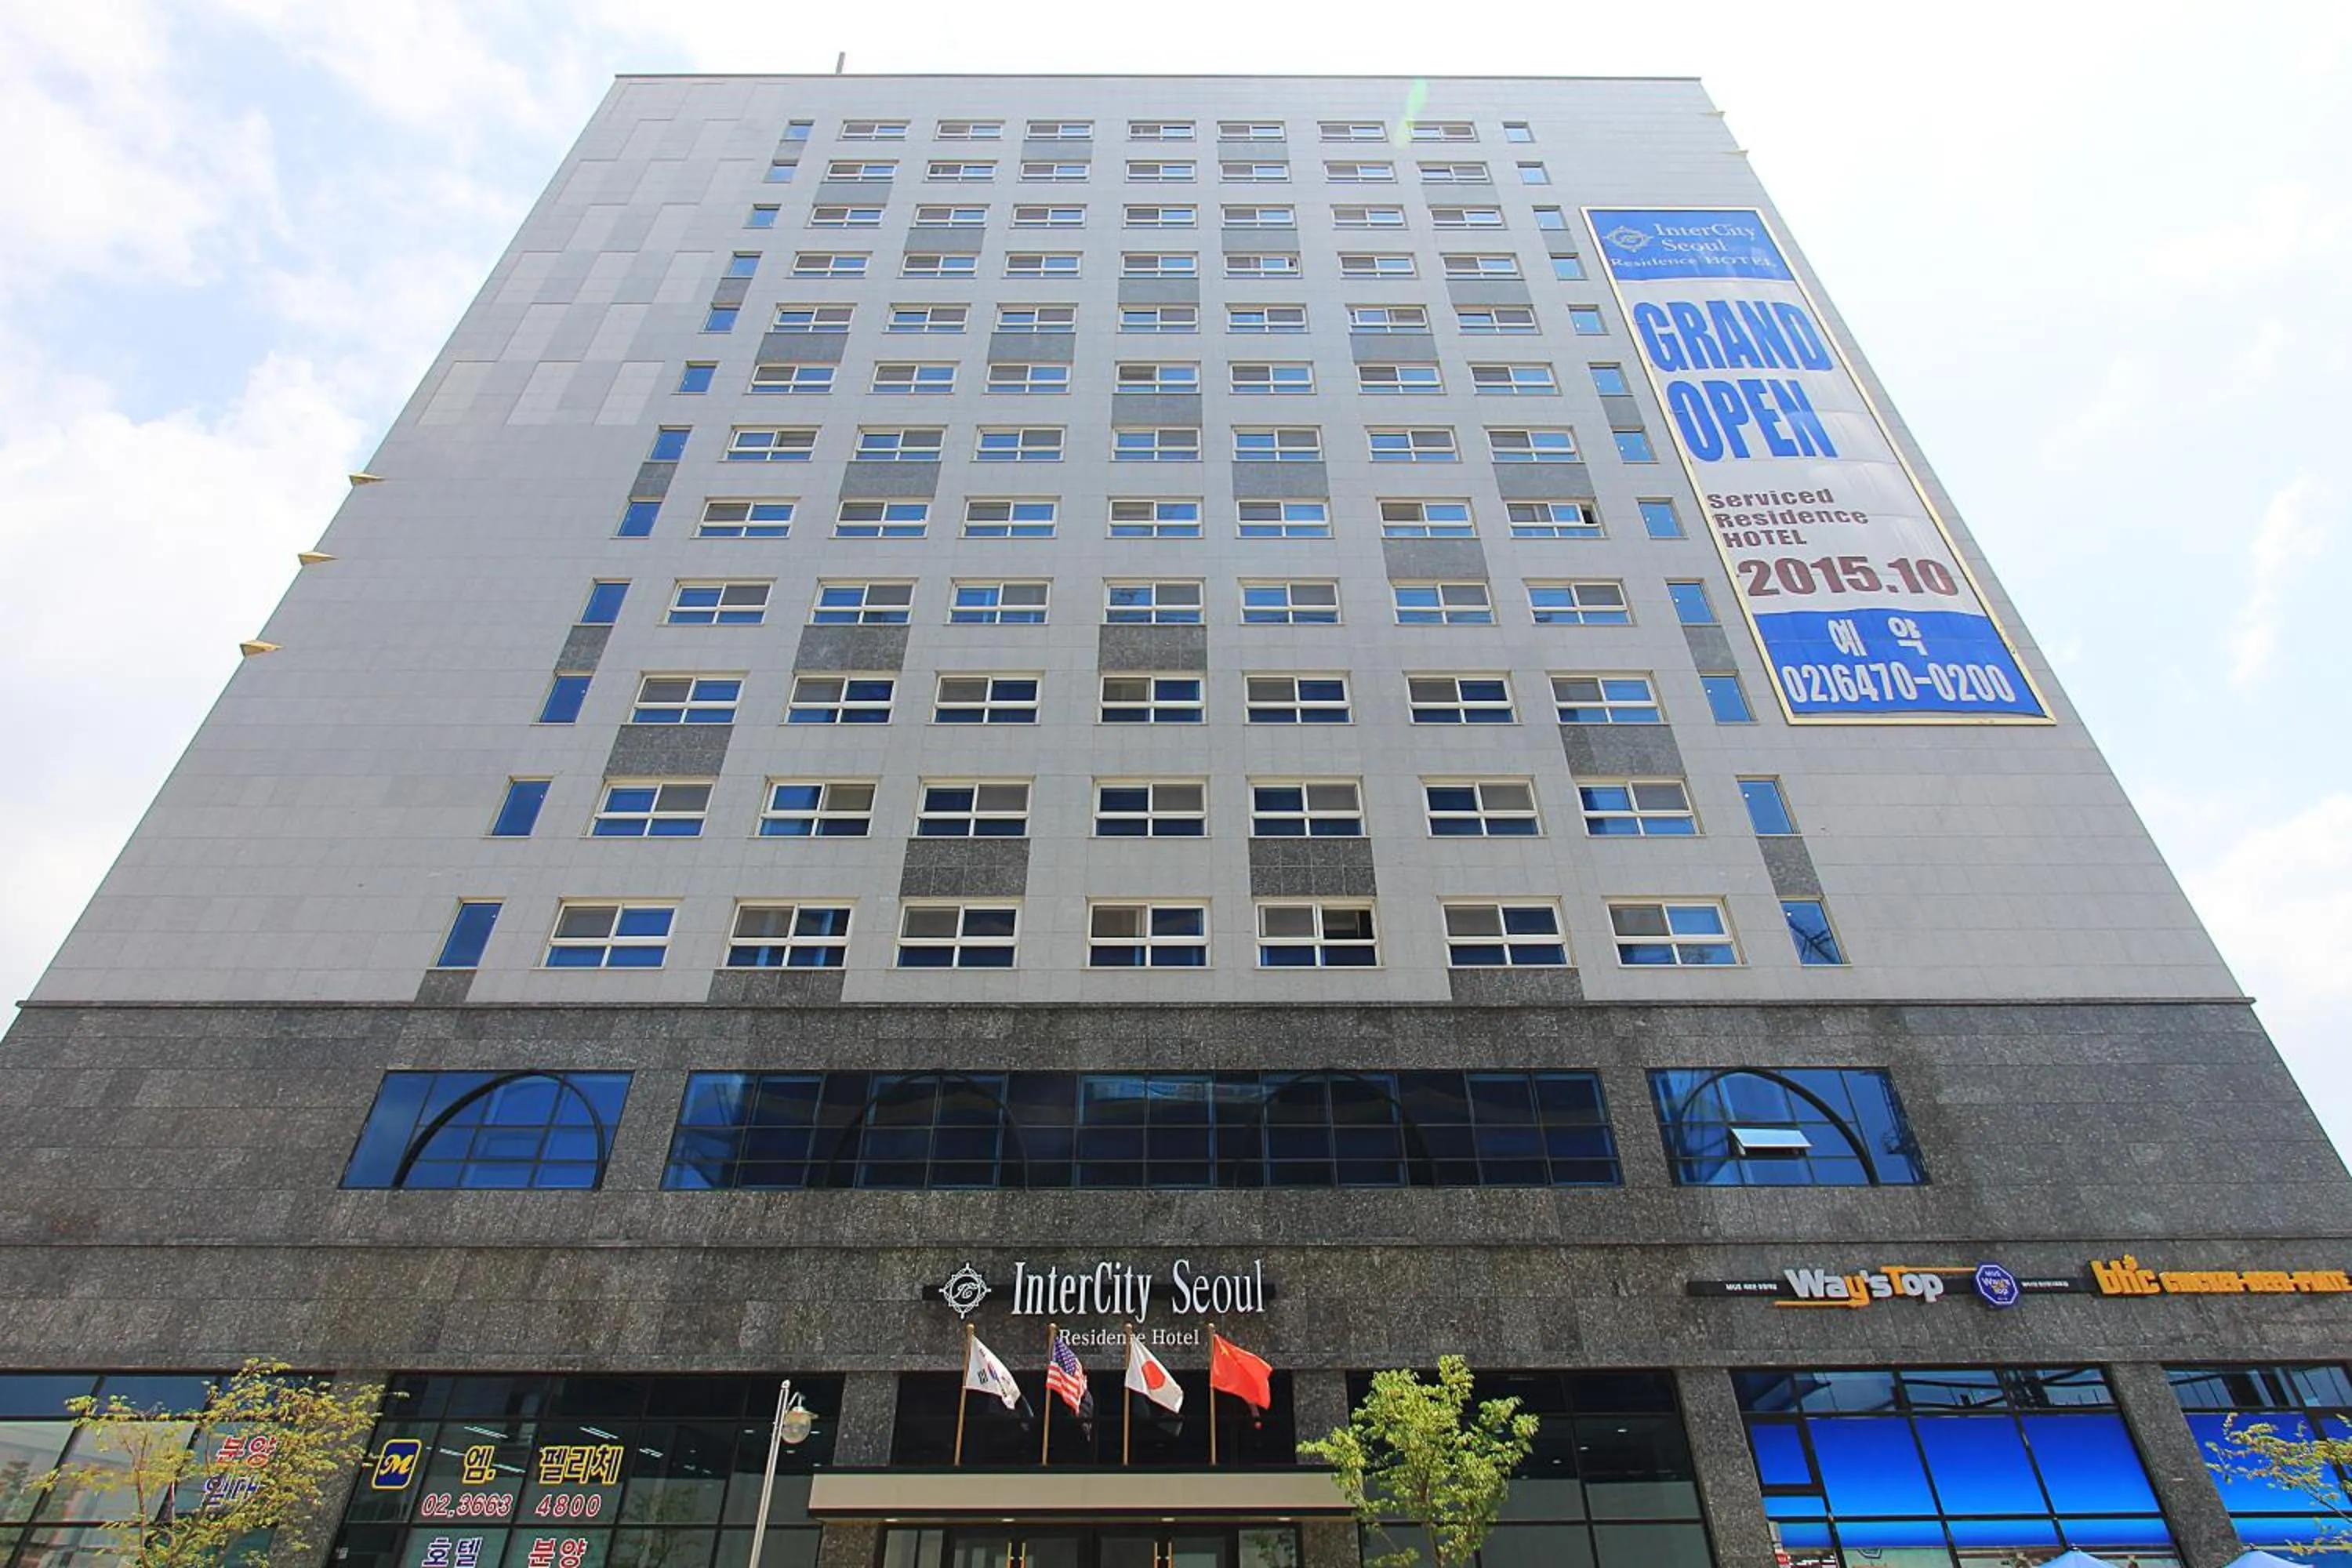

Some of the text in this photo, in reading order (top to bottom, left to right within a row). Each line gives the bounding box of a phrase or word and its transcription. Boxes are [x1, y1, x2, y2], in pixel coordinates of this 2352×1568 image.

[1653, 223, 1756, 241] InterCity
[1661, 238, 1728, 252] Seoul
[1610, 256, 1777, 268] Residence HOTEL
[1634, 301, 1833, 372] GRAND
[1665, 379, 1838, 462] OPEN
[1708, 489, 1834, 510] Serviced
[1713, 510, 1868, 529] Residence
[1722, 529, 1806, 547] HOTEL
[1737, 556, 1959, 597] 2015.10
[1011, 1259, 1265, 1323] InterCity Seoul
[1058, 1329, 1200, 1345] Residene Hotel
[539, 1444, 624, 1485] 펠리체
[421, 1493, 601, 1519] 02.3663 4800
[422, 1537, 483, 1568] 호텔
